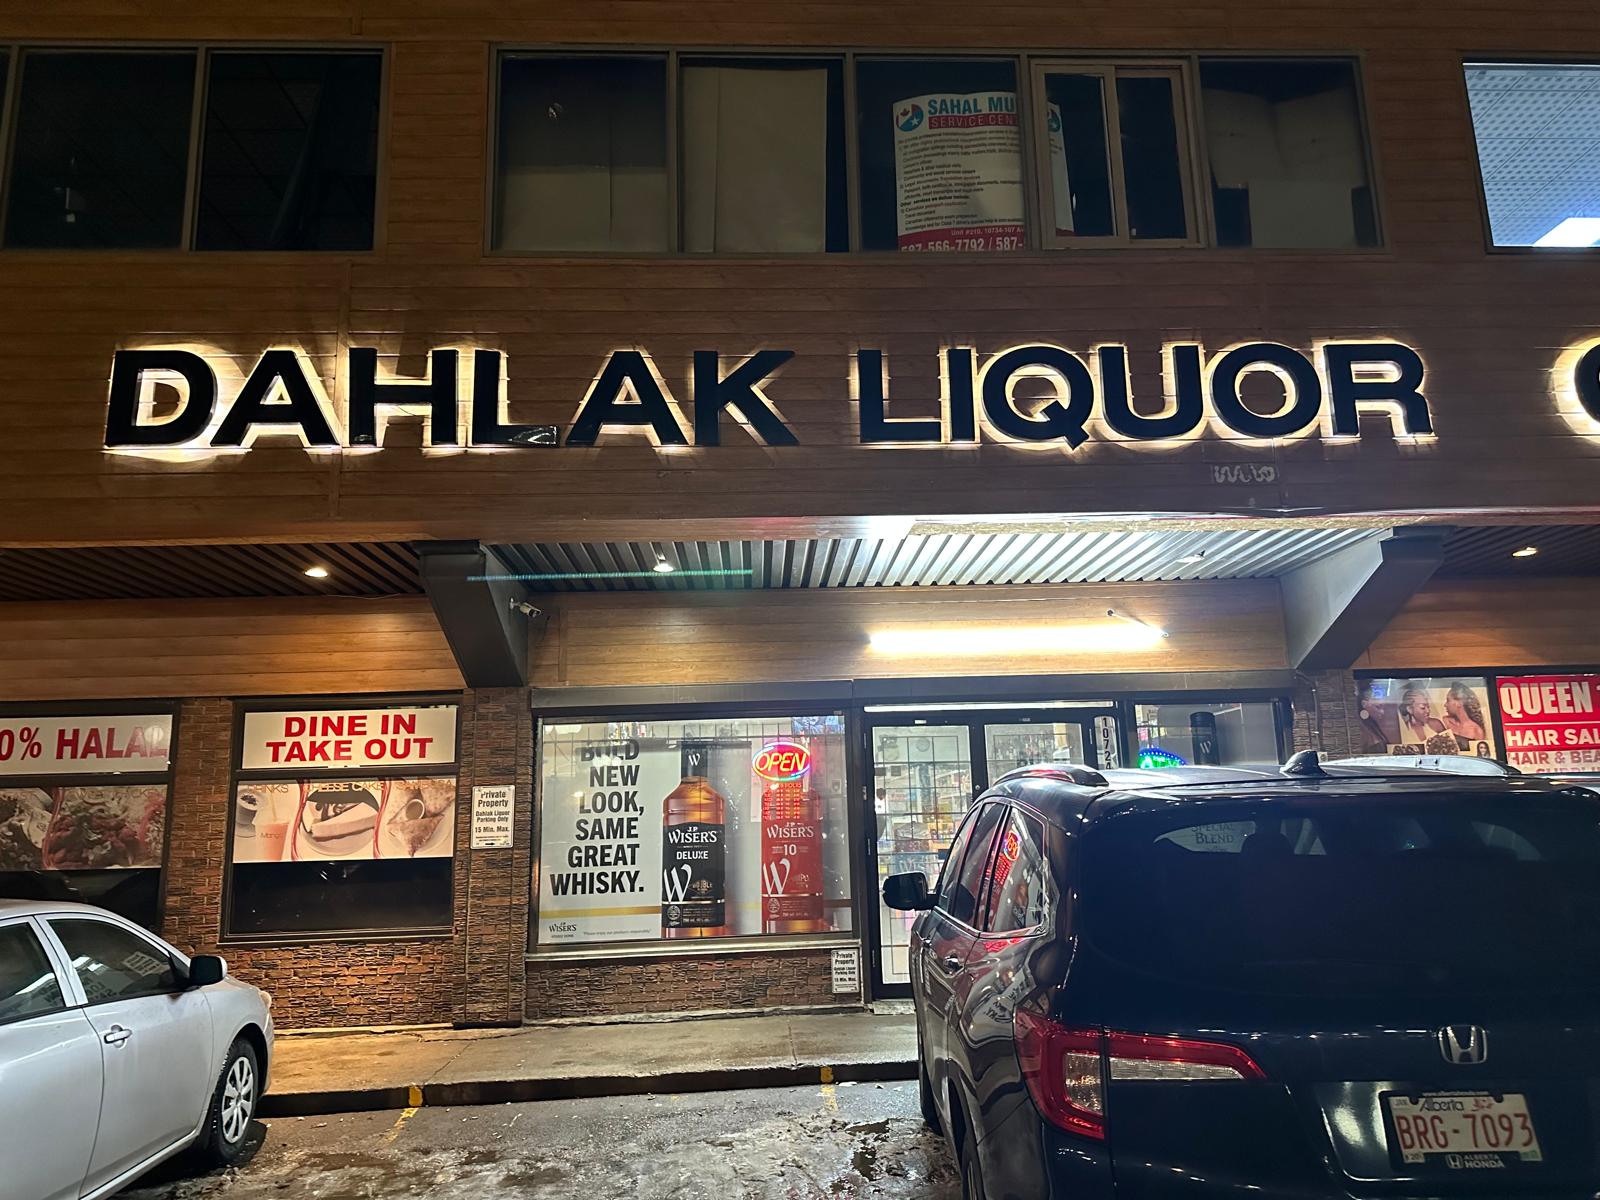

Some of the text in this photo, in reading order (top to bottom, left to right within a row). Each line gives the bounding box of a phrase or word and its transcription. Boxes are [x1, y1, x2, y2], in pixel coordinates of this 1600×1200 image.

[928, 97, 1014, 115] SAHAL MU
[931, 116, 984, 128] SERVICE
[996, 236, 1023, 251] 587-
[105, 343, 1433, 450] DAHLAK LIQUOR
[1500, 682, 1593, 718] QUEEN
[284, 714, 416, 738] DINE IN
[56, 727, 168, 760] HALAL
[1102, 717, 1112, 770] 10724
[1506, 730, 1560, 746] HAIR
[266, 738, 433, 763] TAKE OUT
[1508, 752, 1550, 765] HAIR
[1555, 752, 1565, 764] &
[756, 752, 806, 772] OPEN
[590, 765, 640, 787] NEW
[478, 799, 509, 808] Property
[580, 791, 644, 816] LOOK,
[576, 817, 638, 840] SAME
[668, 828, 718, 844] WISER'S
[767, 824, 814, 838] WISER'S
[1196, 832, 1234, 844] BLEND
[568, 844, 640, 868] GREAT
[676, 851, 708, 860] DELUXE
[784, 844, 797, 856] 10
[550, 870, 644, 896] WHISKY.
[664, 864, 692, 902] W
[763, 858, 790, 896] W
[549, 924, 577, 932] WISER'S
[1420, 1098, 1464, 1112] Alberta
[1396, 1113, 1533, 1149] BRG-7093
[1464, 1160, 1505, 1168] HONDA
